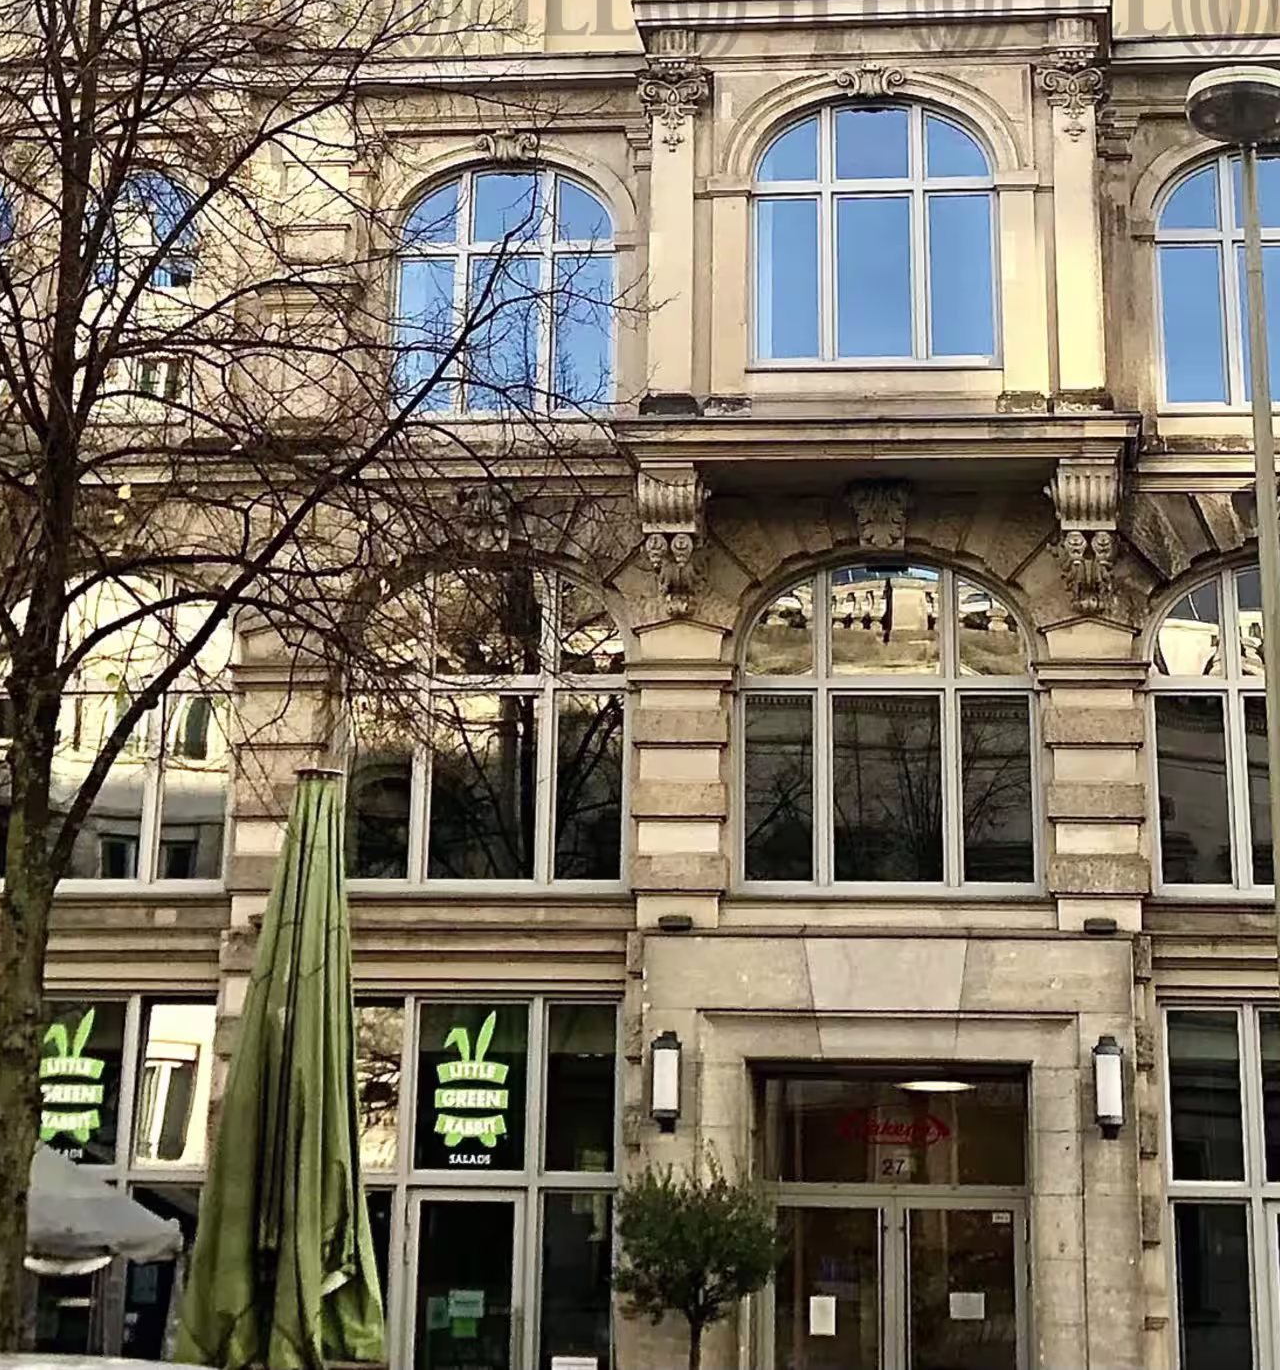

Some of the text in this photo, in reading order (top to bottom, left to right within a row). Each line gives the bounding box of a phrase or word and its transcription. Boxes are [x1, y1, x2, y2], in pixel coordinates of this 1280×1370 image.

[448, 1063, 497, 1080] LITTLE
[441, 1090, 500, 1108] GREEN
[443, 1116, 497, 1138] RABBIT
[448, 1154, 492, 1165] SALADS
[881, 1158, 905, 1176] 27
